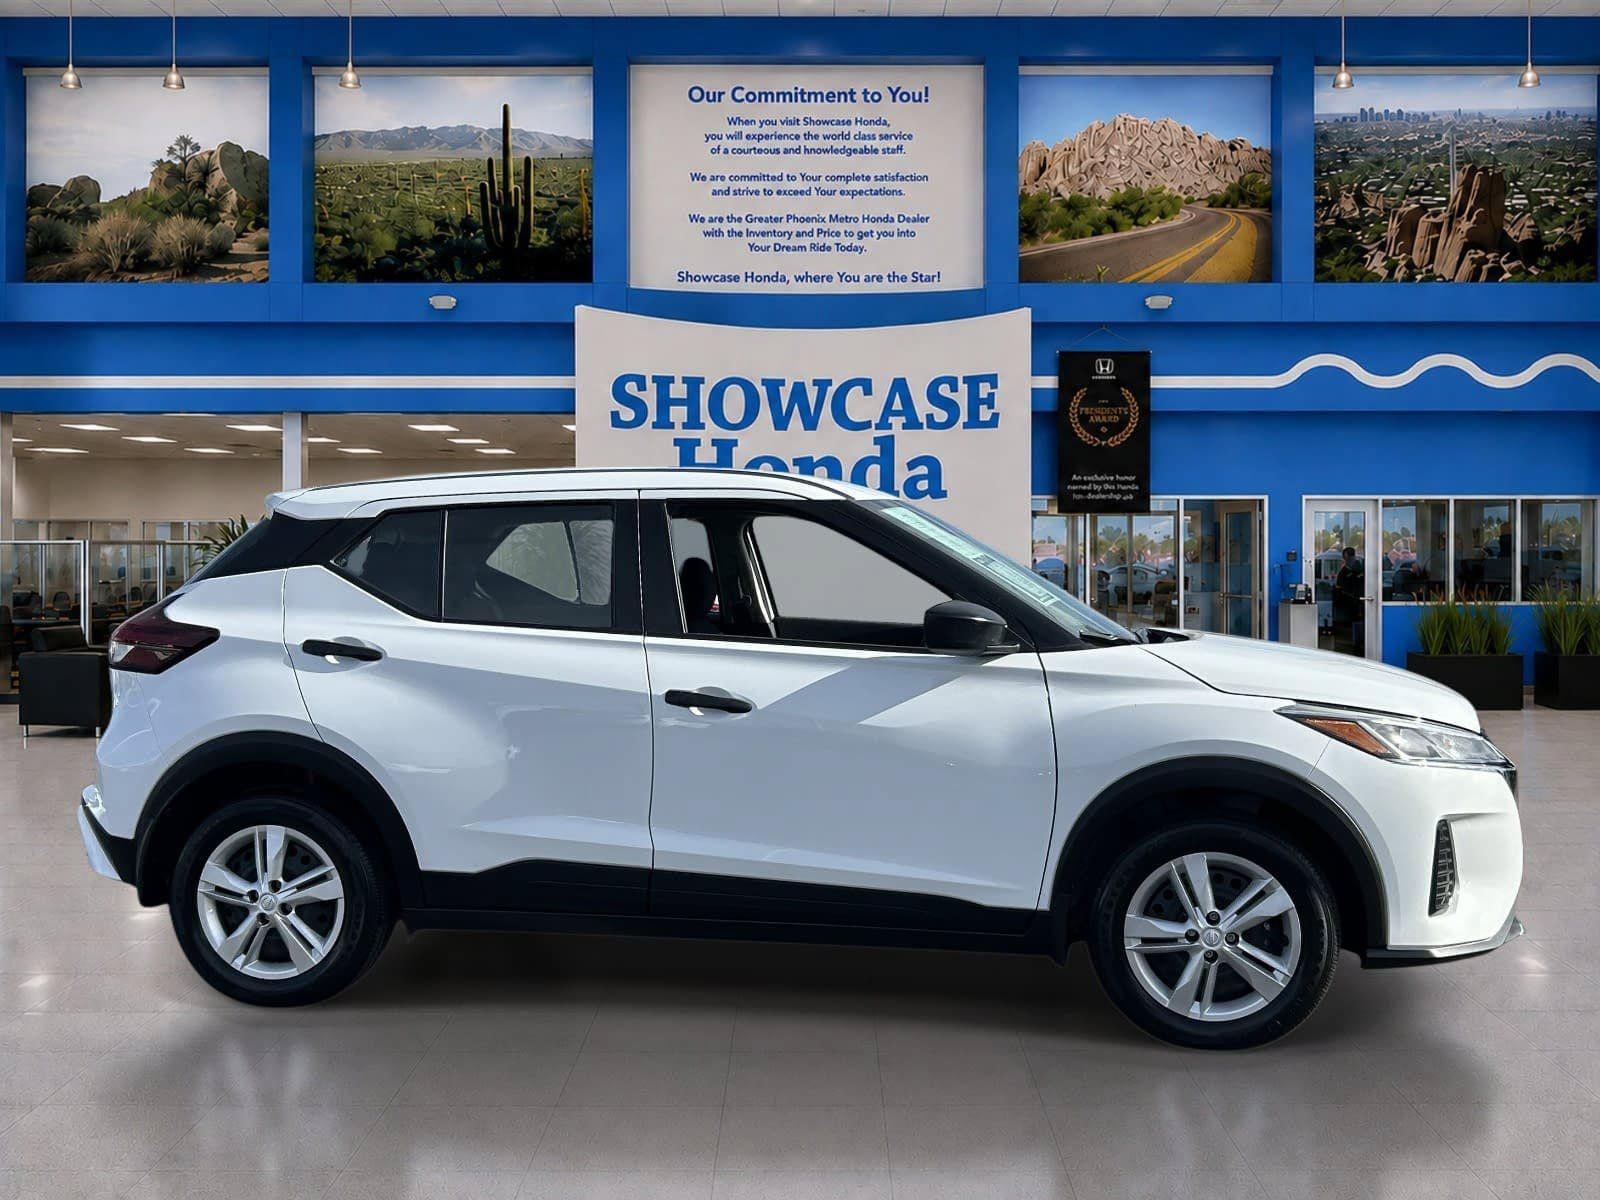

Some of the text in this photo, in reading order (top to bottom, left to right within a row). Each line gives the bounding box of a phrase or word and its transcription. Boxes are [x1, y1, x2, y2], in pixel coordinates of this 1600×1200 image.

[687, 85, 929, 104] Our Commitment to You!
[726, 116, 891, 129] When you visit Showcase Honda,
[704, 130, 914, 144] you will experience the world class service
[709, 144, 721, 156] of
[722, 147, 730, 156] a
[730, 146, 781, 156] courteous
[782, 144, 802, 155] and
[881, 143, 906, 155] staff.
[689, 171, 929, 185] We are committed to Your complete satisfaction
[711, 185, 906, 200] and strive to exceed Your expectations.
[687, 212, 931, 225] We are the Greater Phoenix Metro Honda Dealer
[702, 227, 917, 241] with the Inventory and Price to get you into
[747, 241, 868, 255] Your Dream Ride Today.
[676, 270, 941, 286] Showcase Honda, where You are the Star!
[610, 373, 1000, 431] SHOWCASE
